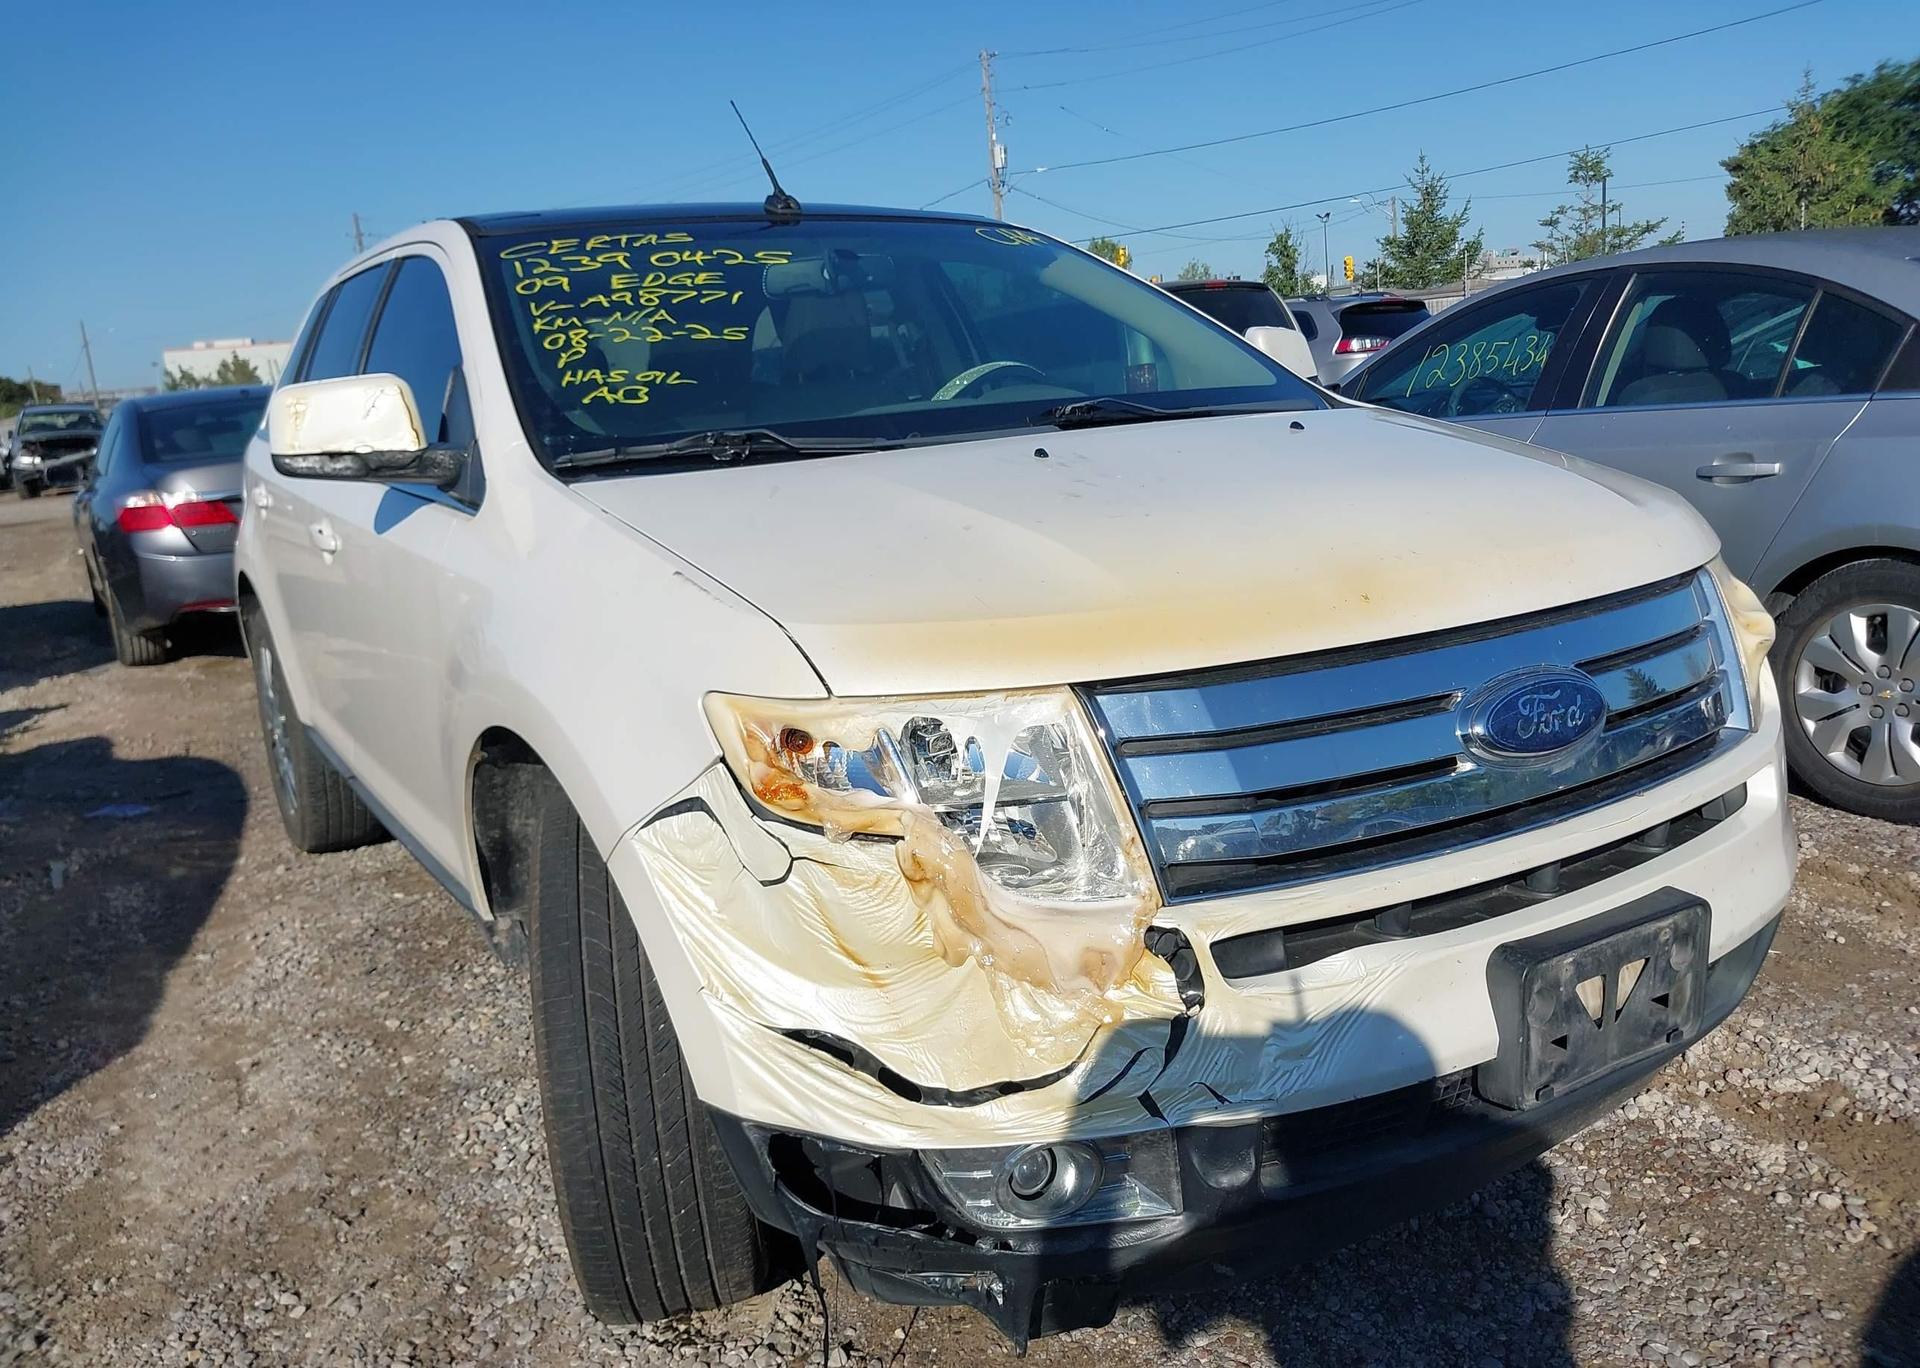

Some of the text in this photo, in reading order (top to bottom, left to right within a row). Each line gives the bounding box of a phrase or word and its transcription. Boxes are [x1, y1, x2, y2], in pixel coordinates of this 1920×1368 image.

[500, 233, 694, 259] CERTAS
[514, 249, 793, 277] 1239 0425
[515, 272, 728, 295] 09 EDGE
[543, 324, 749, 350] 08-22-25
[1406, 333, 1550, 398] 12385434
[582, 385, 650, 404] AB
[1517, 689, 1586, 739] Ford
